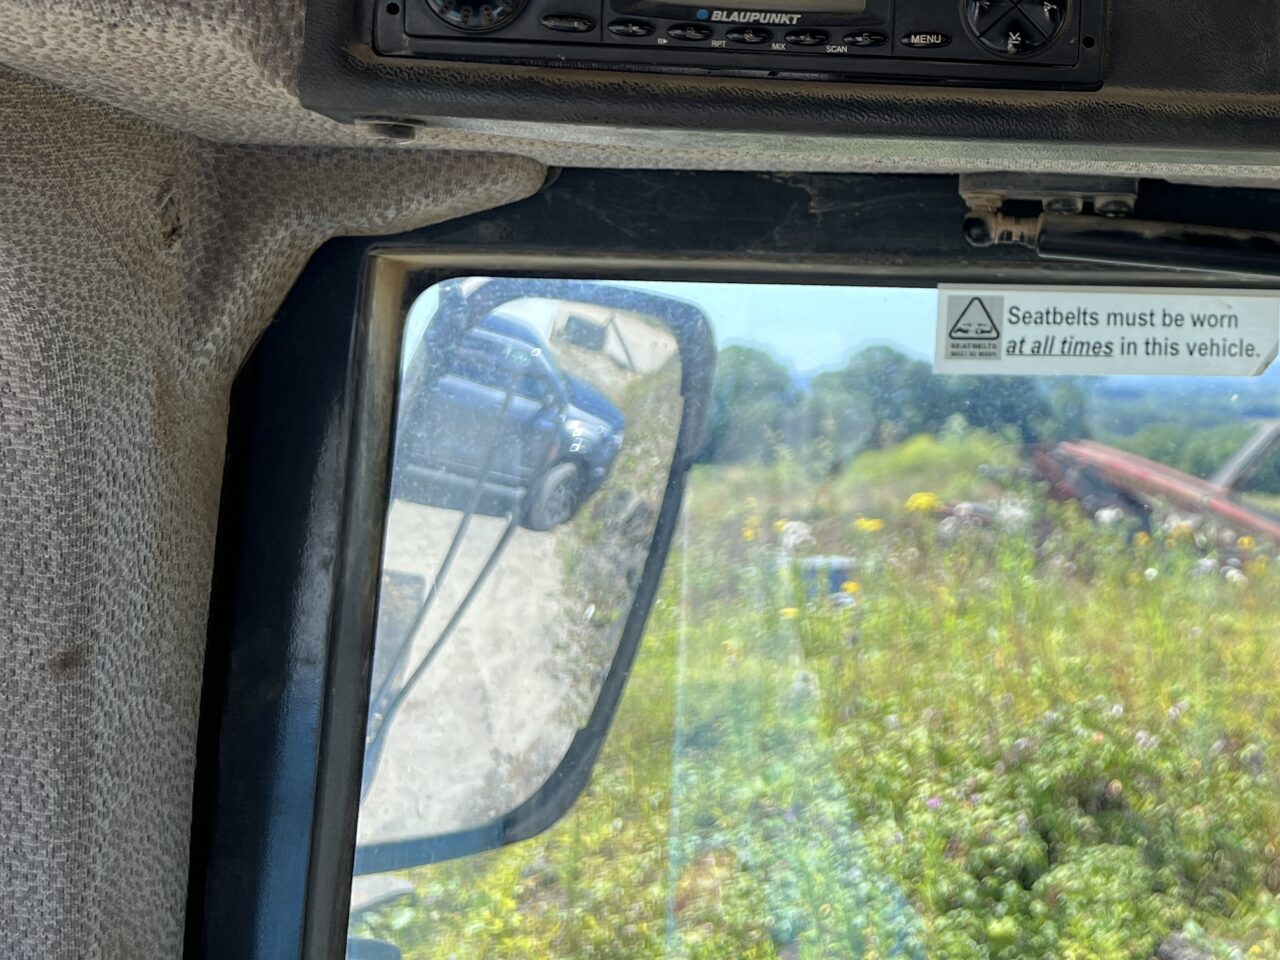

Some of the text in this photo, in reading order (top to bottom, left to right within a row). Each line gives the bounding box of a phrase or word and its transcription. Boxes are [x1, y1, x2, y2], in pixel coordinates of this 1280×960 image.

[711, 10, 803, 26] BLAUPUNKT
[910, 33, 943, 45] MENU
[771, 43, 787, 51] MIX
[826, 45, 848, 54] SCAN
[1007, 305, 1239, 328] Seatbelts must be worn
[1006, 335, 1261, 358] at all times in this vehicle.
